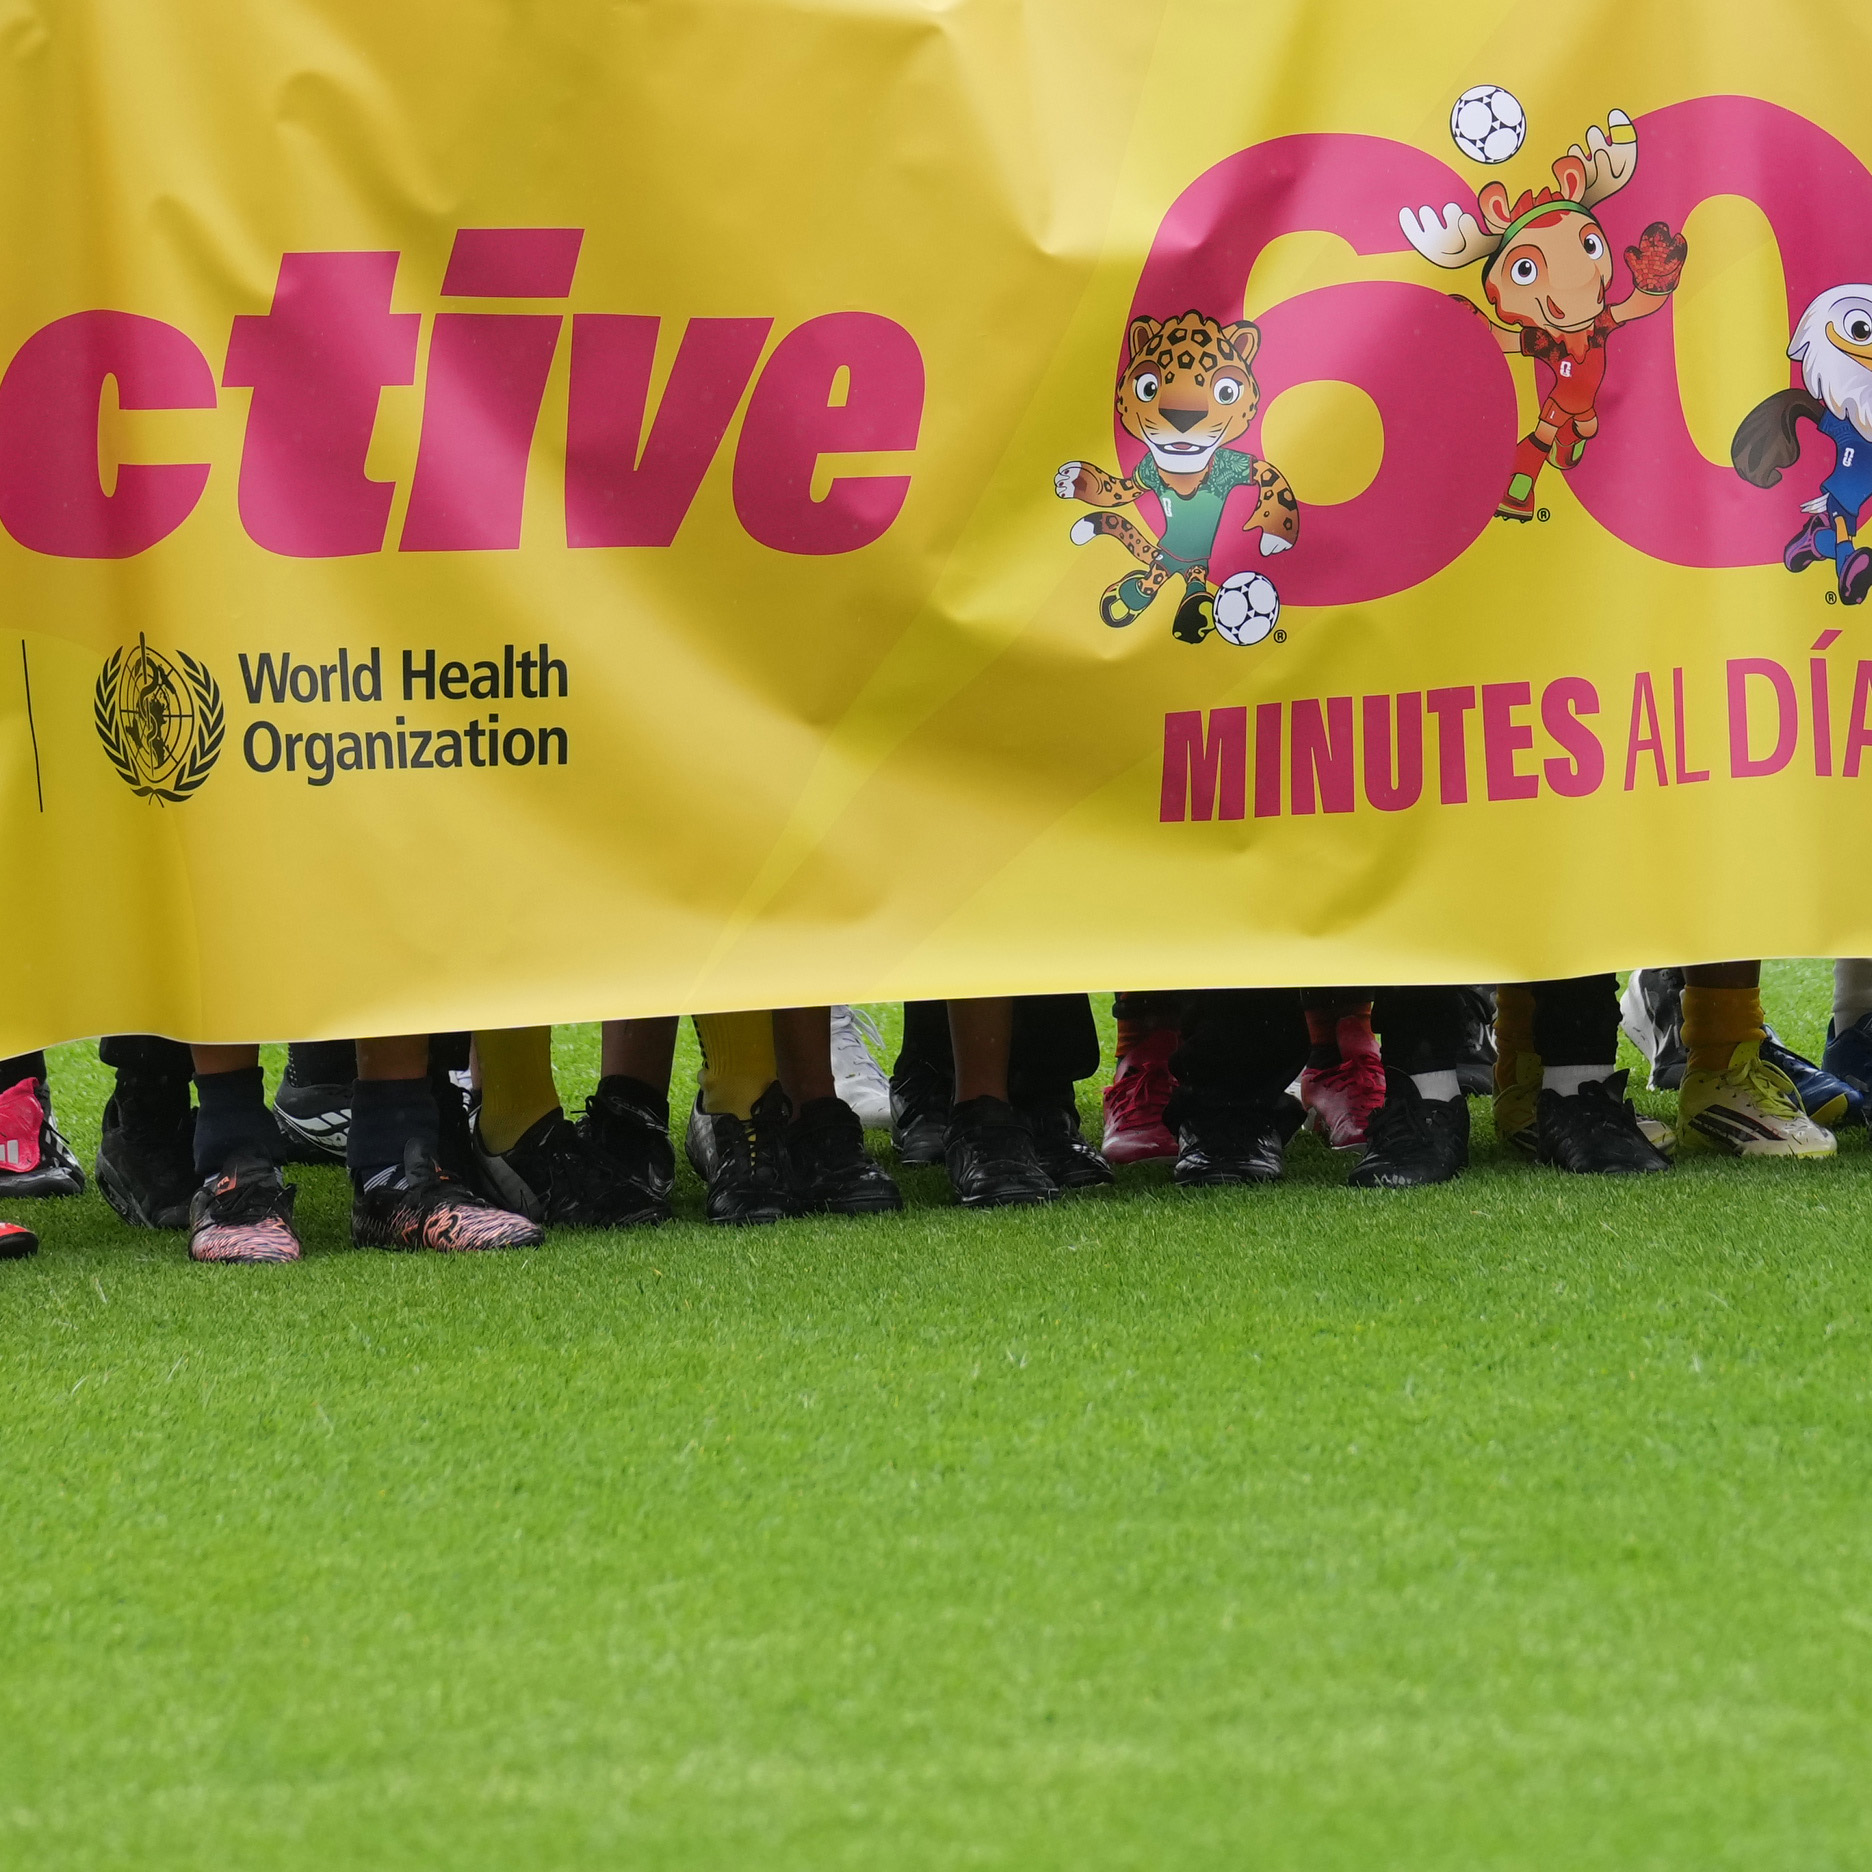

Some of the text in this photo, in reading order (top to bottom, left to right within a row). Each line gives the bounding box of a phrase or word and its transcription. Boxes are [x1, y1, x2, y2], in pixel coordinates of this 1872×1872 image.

[239, 643, 569, 705] World Health
[242, 714, 569, 788] Organization
[1158, 675, 1606, 825] MINUTES
[1623, 665, 1710, 792] AL
